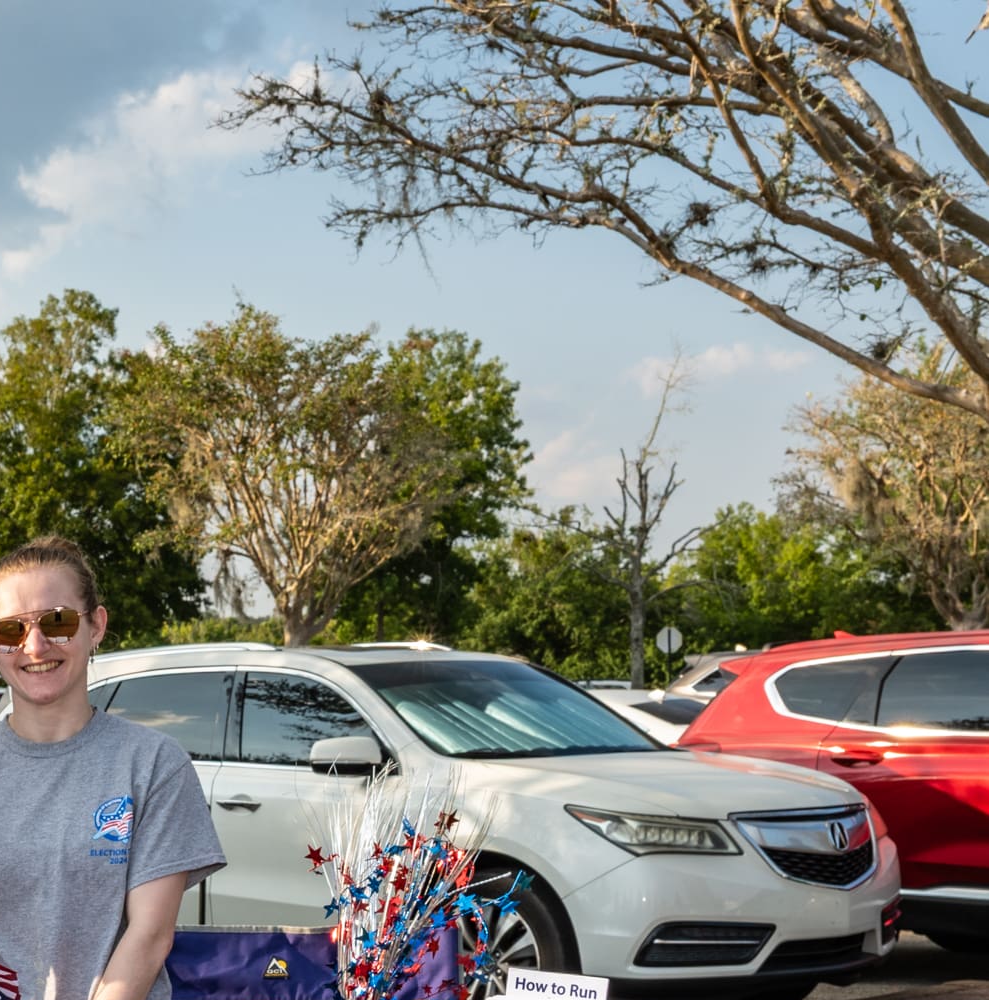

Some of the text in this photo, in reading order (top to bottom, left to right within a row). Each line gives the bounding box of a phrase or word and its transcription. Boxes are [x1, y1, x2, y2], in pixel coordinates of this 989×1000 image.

[90, 848, 127, 857] ELECTION
[514, 976, 598, 1000] How to Run
